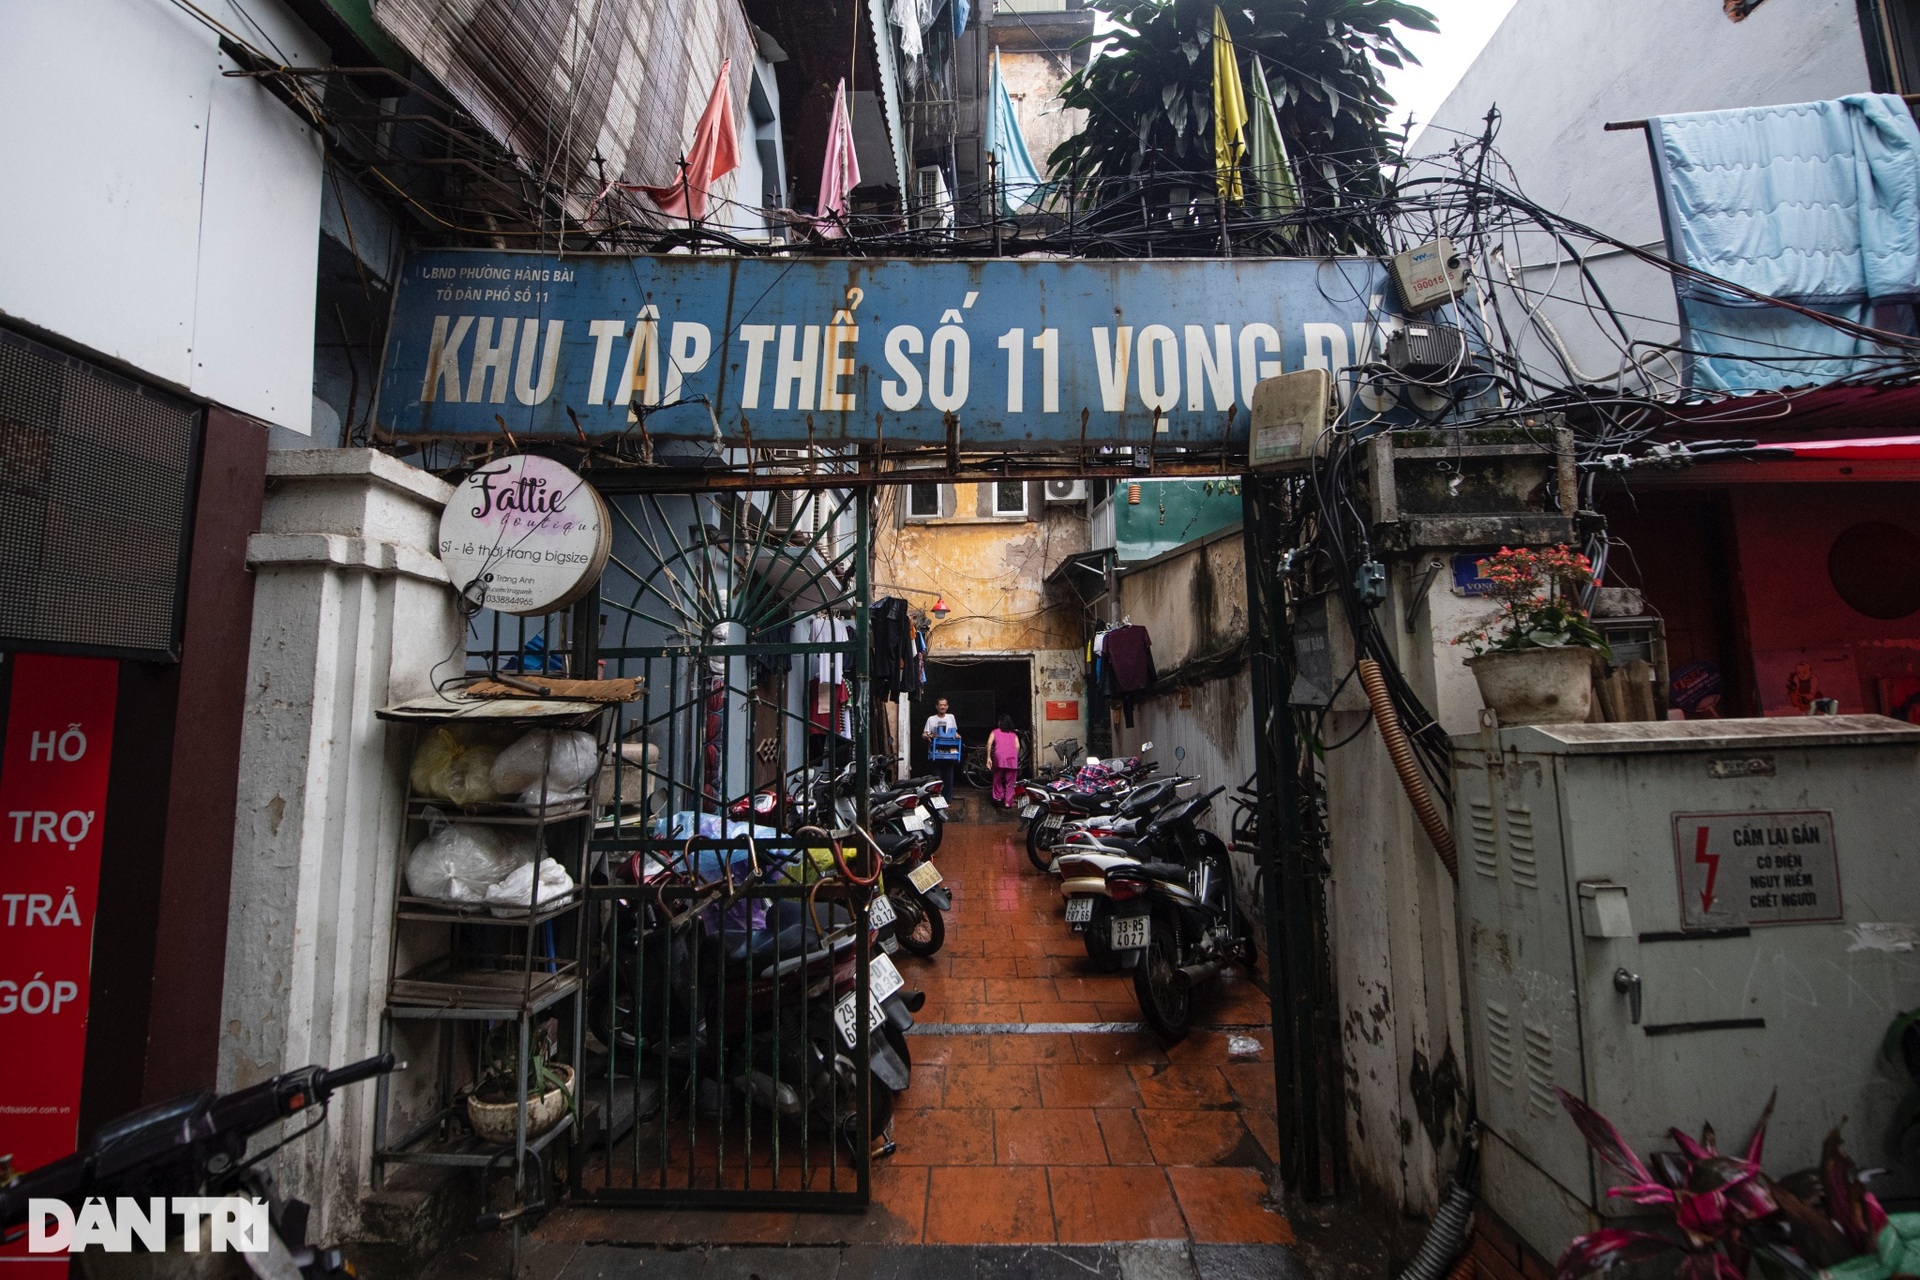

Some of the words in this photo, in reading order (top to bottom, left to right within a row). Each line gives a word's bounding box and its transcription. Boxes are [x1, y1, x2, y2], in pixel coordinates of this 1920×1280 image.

[459, 264, 511, 280] PHƯỜNG
[514, 266, 550, 281] HÀNG
[553, 267, 574, 282] BÀI
[437, 283, 453, 301] TỔ
[455, 286, 482, 301] DÂN
[485, 284, 511, 301] PHỐ
[514, 286, 531, 303] SỐ
[535, 291, 549, 303] 11
[421, 315, 565, 406] KHU
[586, 304, 711, 422] TẬP
[738, 287, 864, 411] THỂ
[881, 291, 979, 413] SỐ
[998, 327, 1059, 413] 11
[1092, 322, 1282, 434] VỌNG
[469, 464, 567, 518] Fattie
[501, 512, 600, 536] boutique
[462, 542, 474, 555] lẻ
[478, 545, 503, 557] thời
[506, 548, 541, 563] trang
[545, 550, 588, 565] bigsize
[497, 574, 517, 585] Trang
[519, 576, 535, 585] Anh
[486, 594, 533, 606] 0338844965
[29, 722, 88, 763] HỖ
[8, 810, 95, 851] TRỢ
[1767, 828, 1788, 850] LẠI
[1775, 852, 1803, 872] ĐIỆN
[1750, 875, 1780, 889] NGUY
[1783, 868, 1813, 887] HIỂM
[2, 886, 82, 927] TRẢ
[1070, 900, 1089, 911] 29-C1
[1750, 891, 1778, 909] CHẾT
[1781, 888, 1817, 907] NGƯỜI
[1117, 919, 1144, 934] 33-R5
[1117, 933, 1144, 947] 4027
[0, 971, 78, 1015] GÓP
